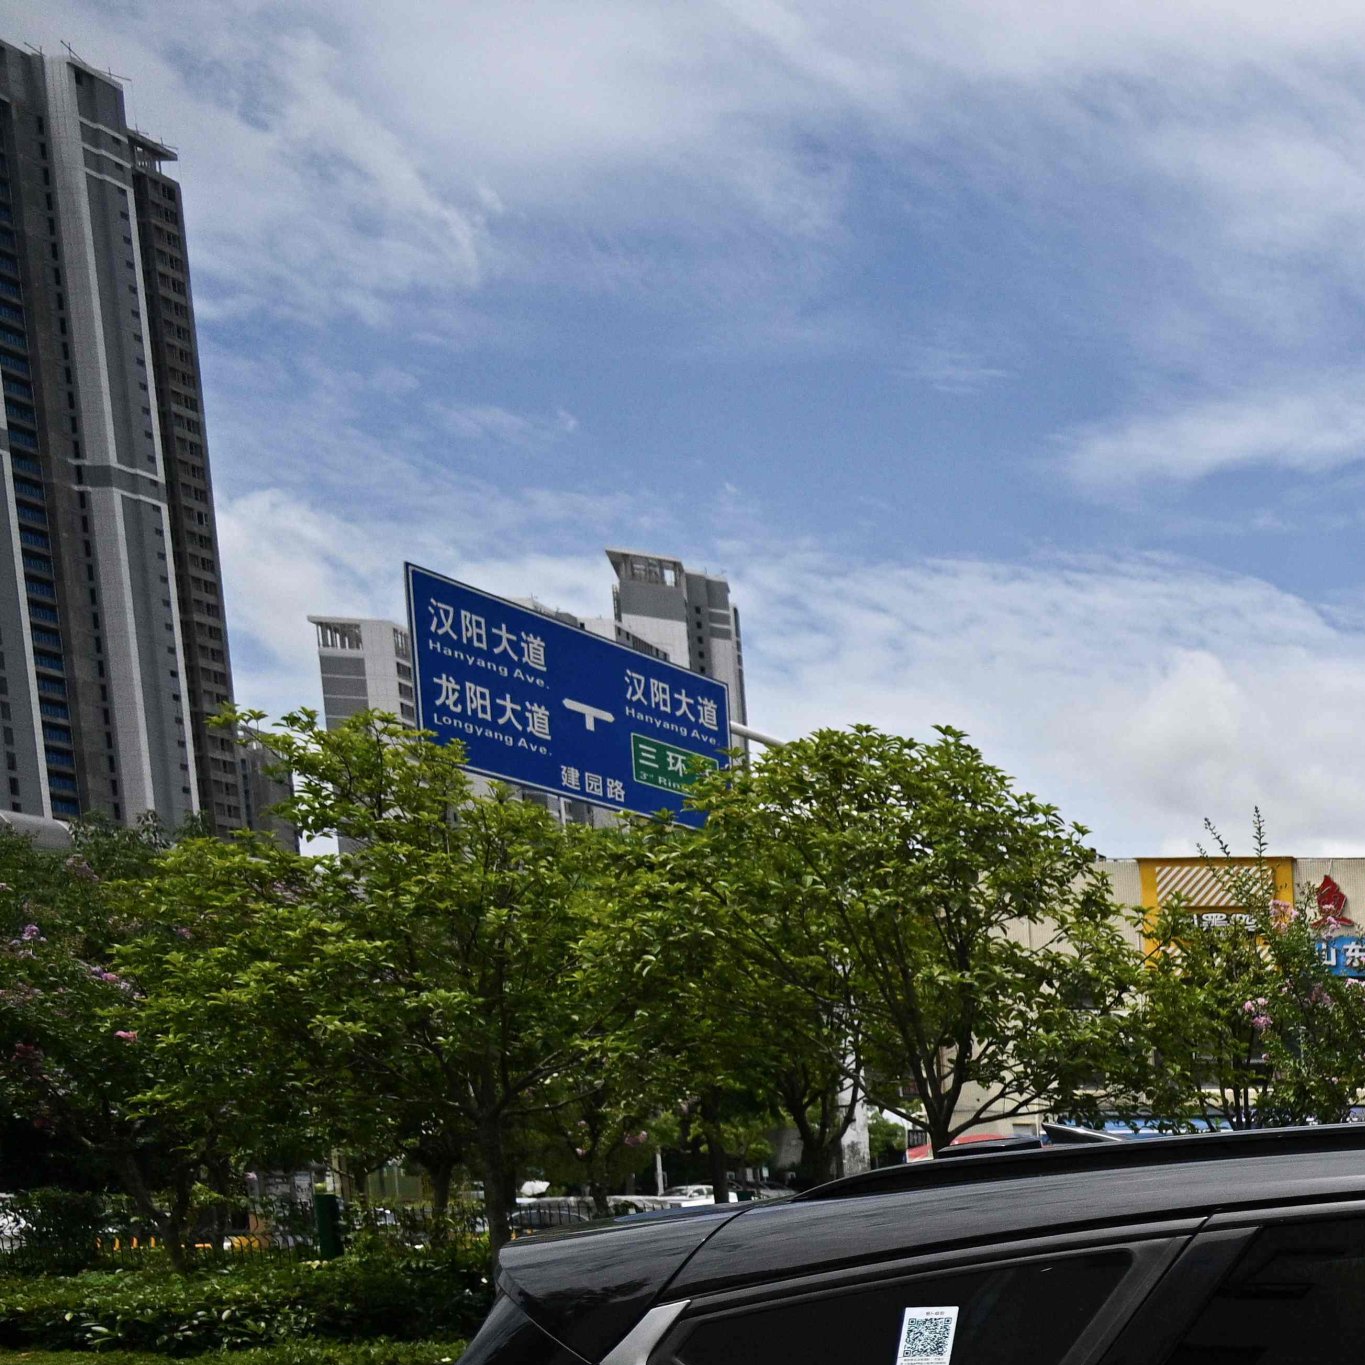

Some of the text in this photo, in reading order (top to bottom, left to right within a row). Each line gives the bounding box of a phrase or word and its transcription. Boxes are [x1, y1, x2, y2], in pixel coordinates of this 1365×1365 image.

[428, 597, 548, 672] 汉阳大道
[429, 638, 550, 690] Hanyang Ave.
[432, 672, 552, 741] 龙阳大道
[624, 668, 719, 732] 汉阳大道
[625, 706, 720, 746] Hanyang Ave.
[434, 712, 553, 757] Longyang Ave.
[560, 765, 626, 803] 建园路
